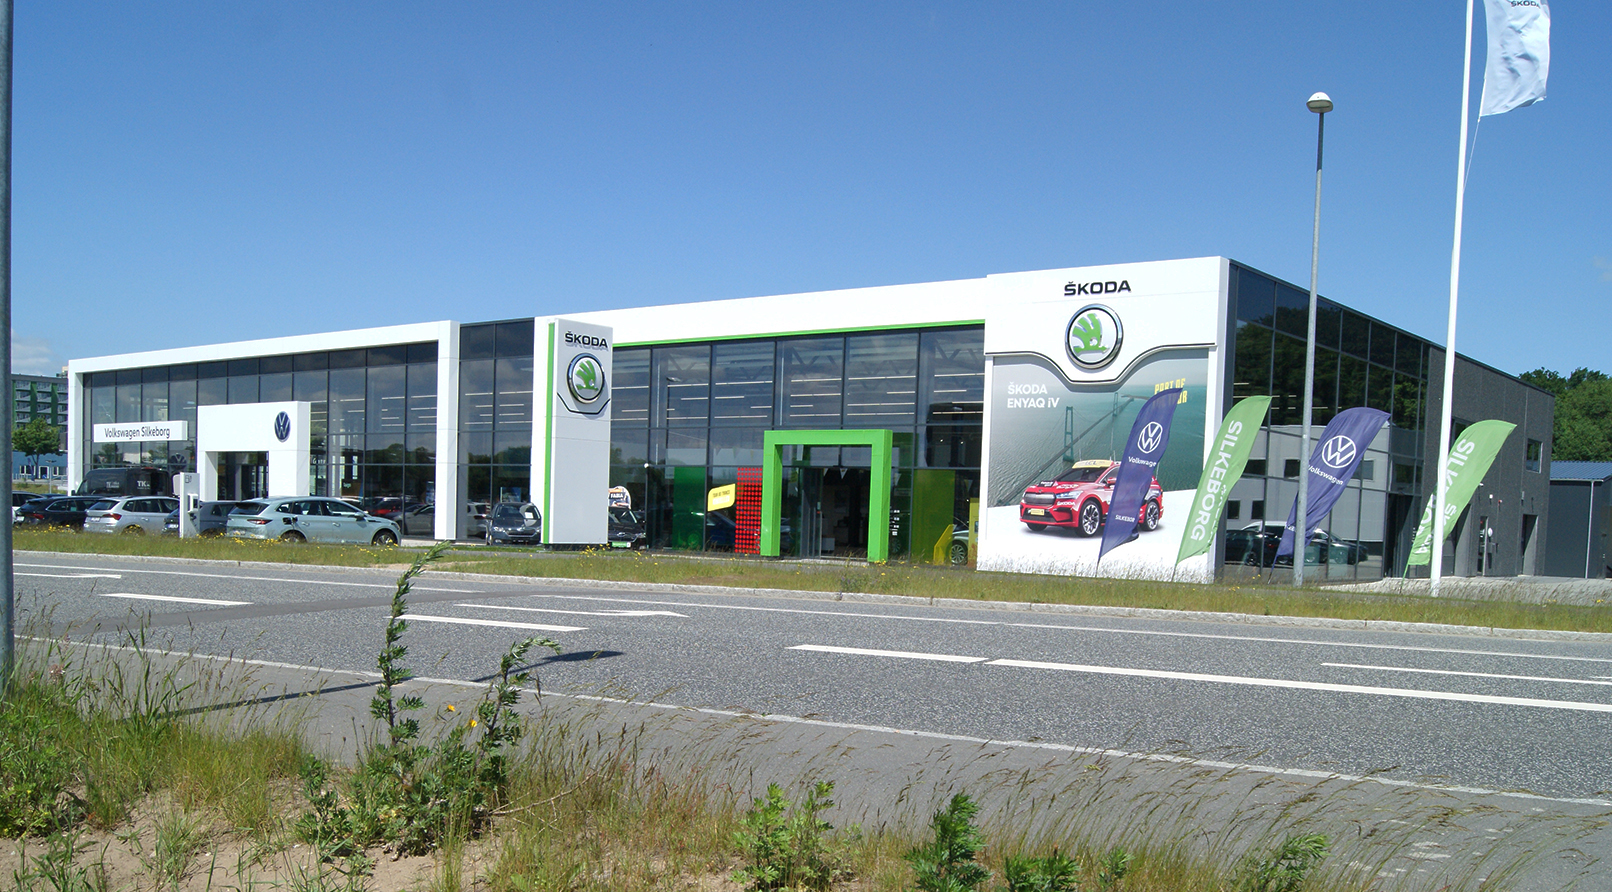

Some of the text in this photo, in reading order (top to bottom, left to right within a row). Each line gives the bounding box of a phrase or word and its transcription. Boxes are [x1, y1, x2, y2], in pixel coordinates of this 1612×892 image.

[1064, 280, 1131, 296] ŠKODA
[565, 331, 608, 348] ŠKODA
[1007, 381, 1047, 395] ŠKODA
[1007, 398, 1045, 410] ENYAQ
[105, 426, 170, 440] Volkswagen Silkeborg
[1190, 421, 1243, 542] SILKEBORG
